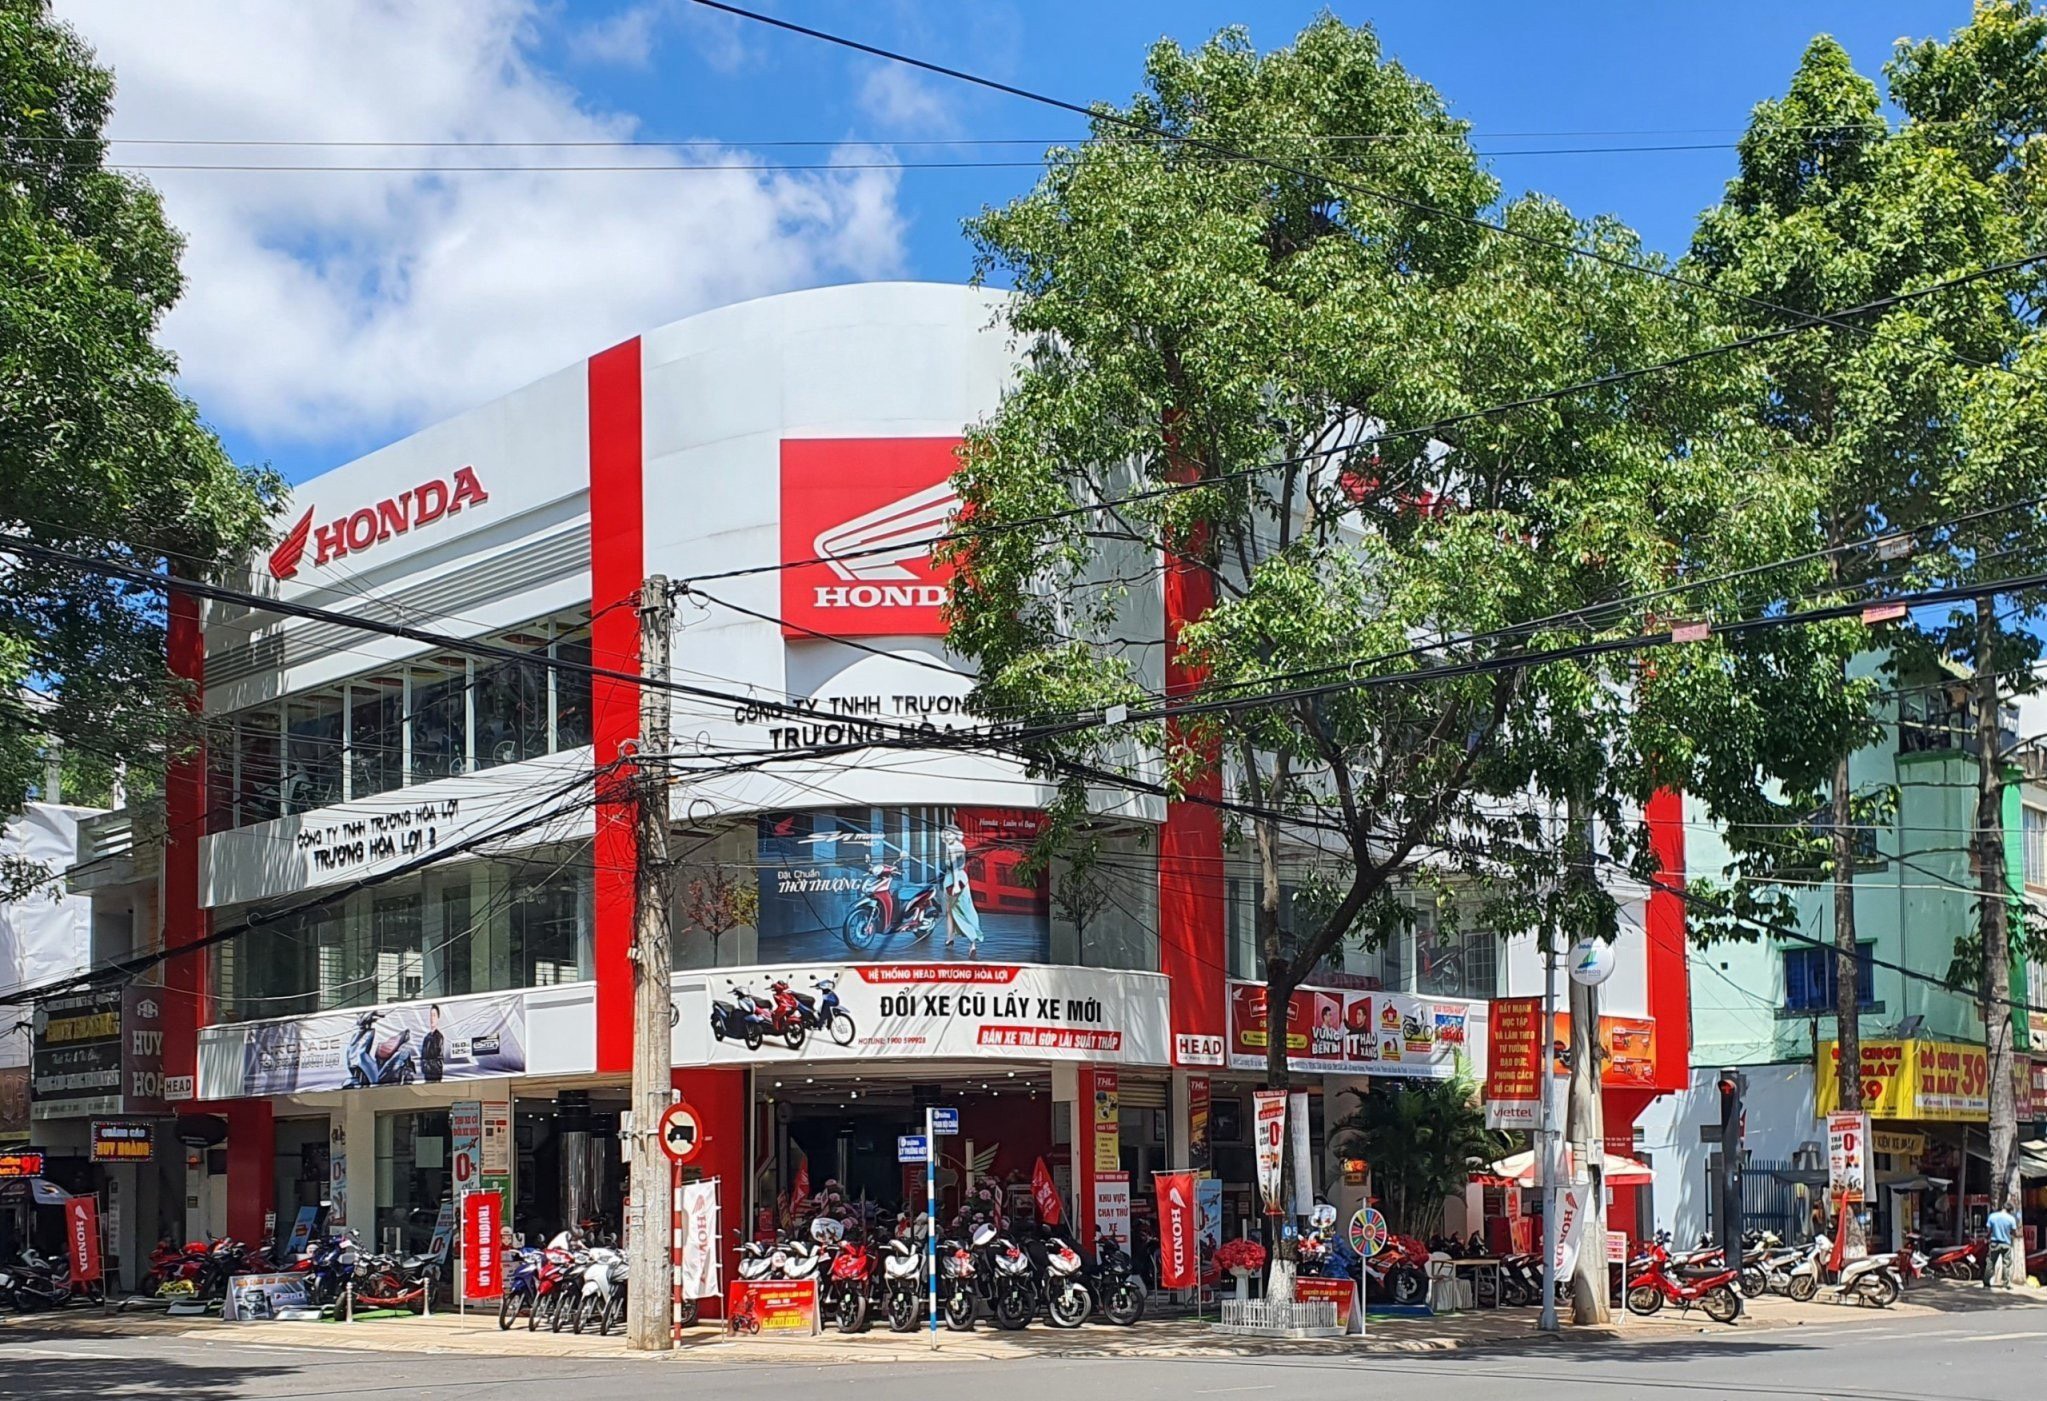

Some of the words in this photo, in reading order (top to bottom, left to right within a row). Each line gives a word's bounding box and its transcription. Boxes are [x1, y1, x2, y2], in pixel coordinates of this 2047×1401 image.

[314, 465, 489, 567] HONDA
[814, 585, 948, 607] HOND
[829, 696, 881, 715] TNHH
[892, 696, 968, 715] TRƯƠN
[298, 829, 321, 849] CÔNG
[327, 826, 338, 841] TY
[343, 820, 365, 841] TNHH
[370, 810, 411, 833] TRƯƠNG
[314, 841, 364, 868] TRƯƠNG
[370, 834, 395, 858] HÒA
[402, 830, 422, 854] LỢI
[429, 827, 436, 848] 2
[808, 877, 862, 893] THƯỢNG
[868, 968, 880, 982] HỆ
[881, 967, 911, 980] THỐNG
[913, 969, 935, 980] HEAD
[938, 968, 971, 980] TRƯƠNG
[973, 967, 993, 980] HÒA
[995, 969, 1008, 982] LỢI
[880, 987, 916, 1018] ĐỔI
[924, 996, 950, 1017] XE
[958, 992, 985, 1017] CŨ
[994, 988, 1030, 1018] LẤY
[1037, 998, 1060, 1020] XE
[1067, 996, 1102, 1022] MỚI
[132, 1030, 164, 1056] HUY
[982, 1030, 1002, 1045] BÁN
[1004, 1033, 1018, 1046] XE
[1020, 1030, 1037, 1046] TRẢ
[1039, 1031, 1057, 1047] GÓP
[1059, 1031, 1072, 1047] LÃI
[1073, 1032, 1097, 1049] SUẤT
[1098, 1033, 1118, 1050] THẤP
[1519, 1030, 1535, 1040] THEO
[1179, 1039, 1222, 1055] HEAD
[1494, 1071, 1516, 1081] PHONG
[1517, 1070, 1534, 1080] CÁCH
[1961, 1053, 1987, 1096] 39
[166, 1080, 192, 1094] HEAD
[1493, 1108, 1533, 1117] viettel
[1099, 1194, 1112, 1203] KHU
[1113, 1193, 1126, 1204] VỰC
[1098, 1208, 1114, 1219] CHẠY
[1116, 1204, 1128, 1217] THỬ
[478, 1205, 491, 1245] TRƯƠNG
[76, 1220, 89, 1272] HONDA
[1170, 1207, 1185, 1279] HONDA
[1555, 1209, 1573, 1267] HONDA
